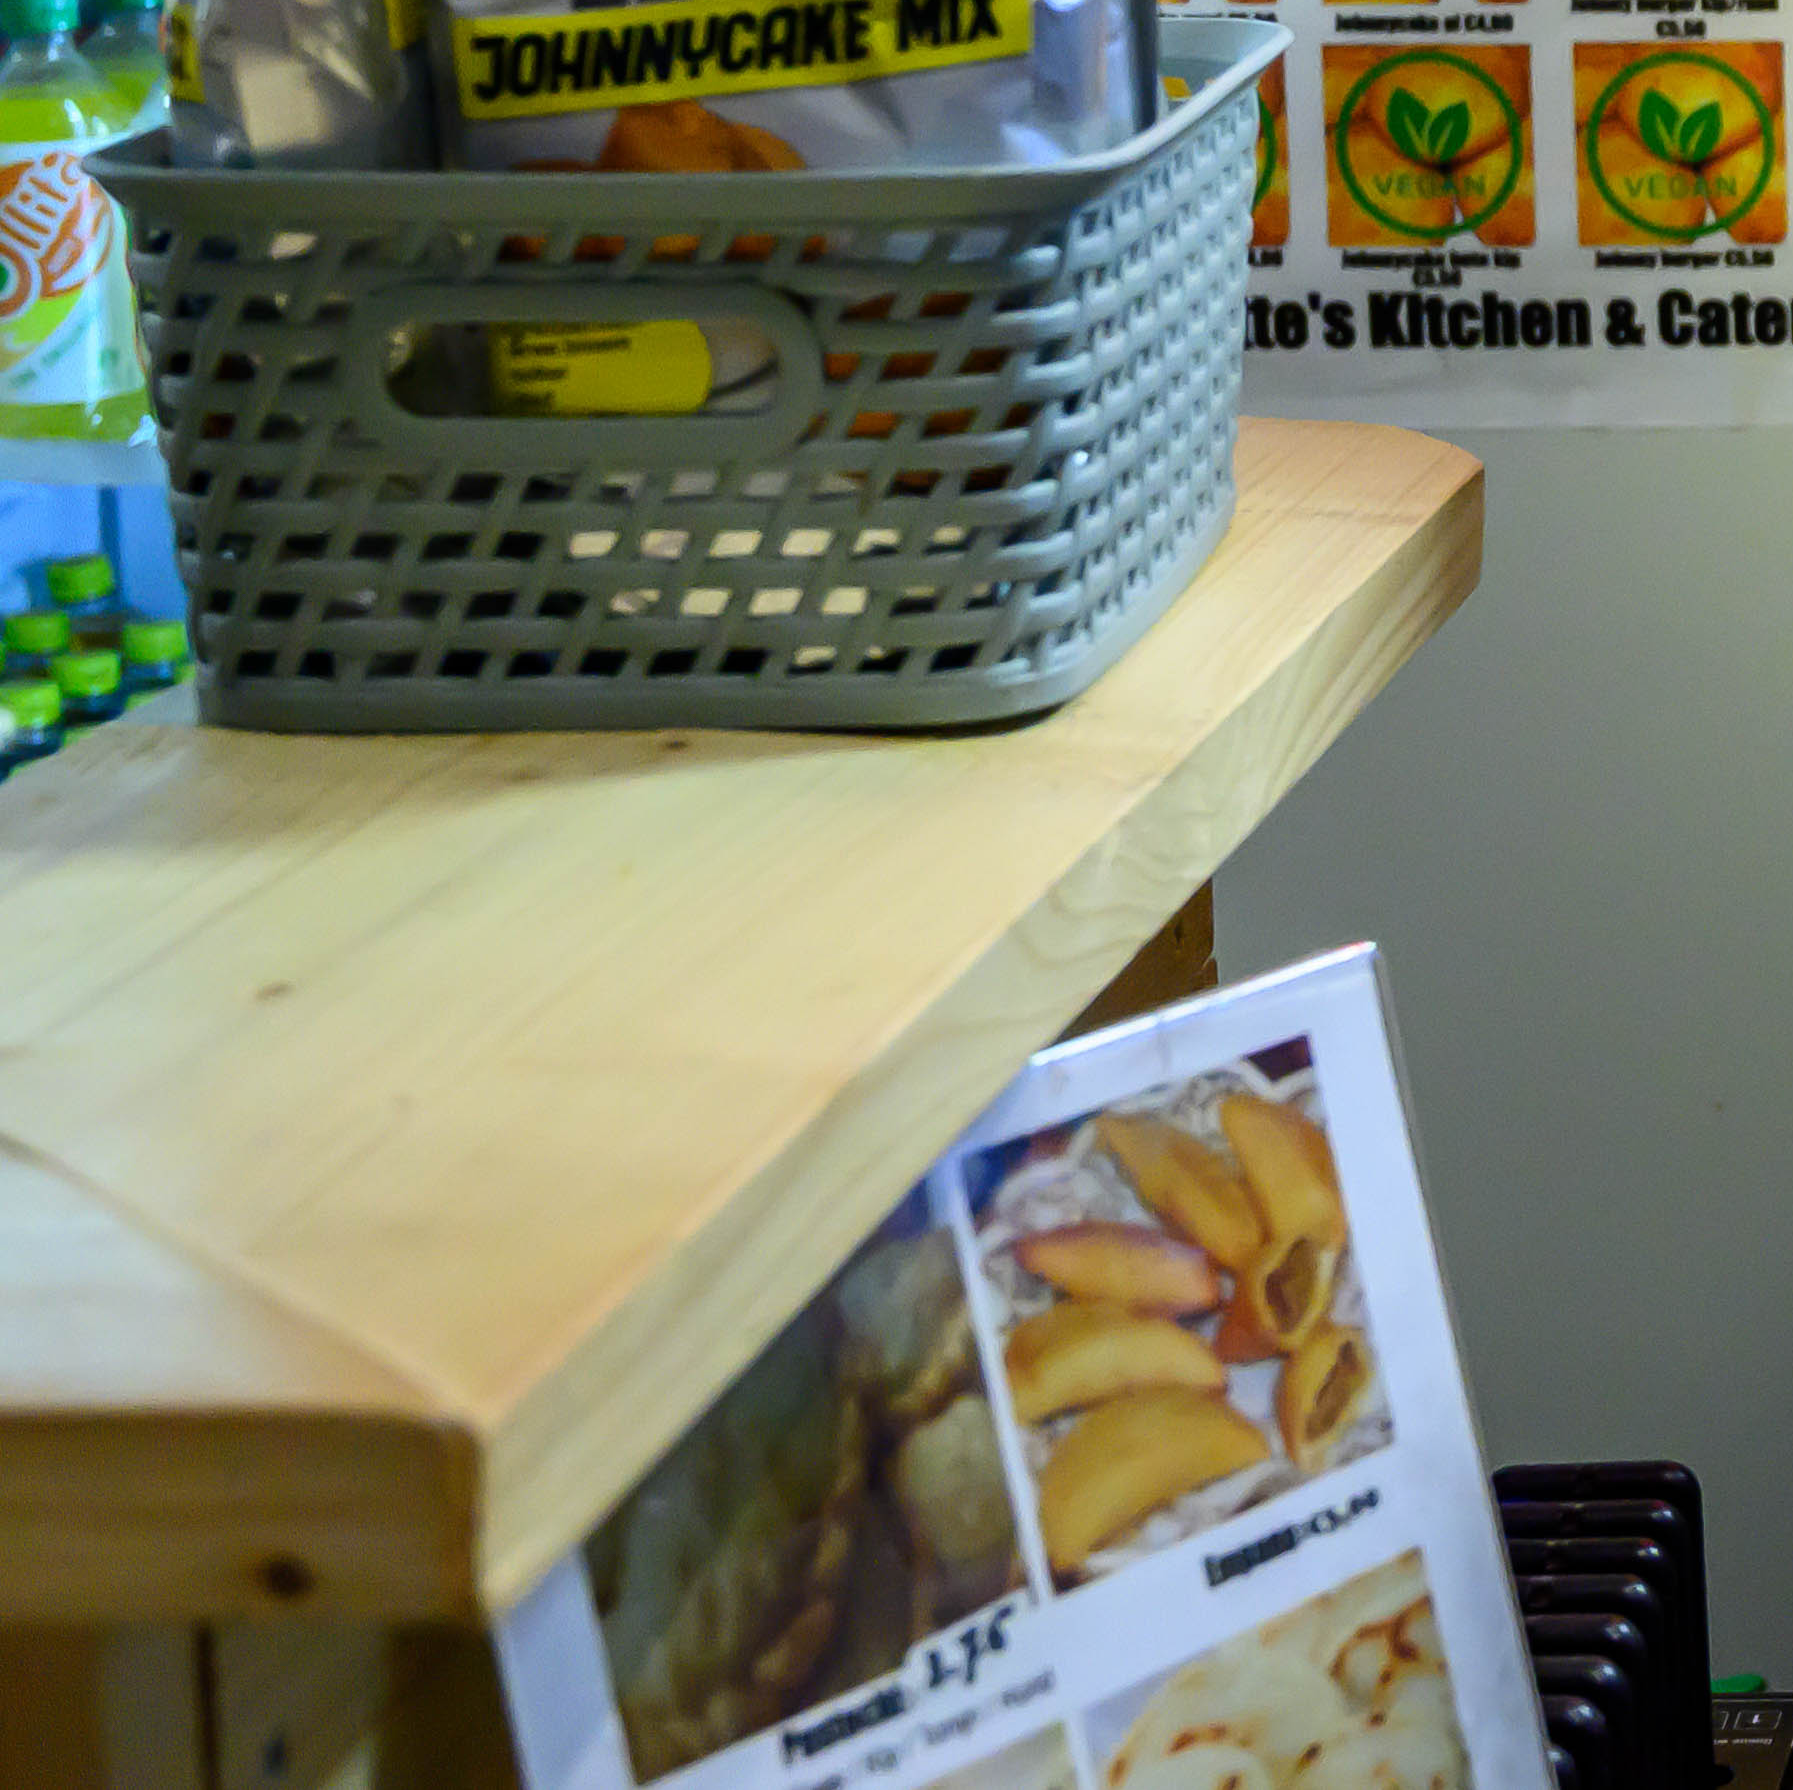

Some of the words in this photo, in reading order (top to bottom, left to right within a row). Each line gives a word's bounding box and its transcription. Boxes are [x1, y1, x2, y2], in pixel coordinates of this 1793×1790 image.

[1624, 174, 1738, 201] VEGAN
[1368, 291, 1592, 349] Kitchen
[1604, 298, 1646, 347] &
